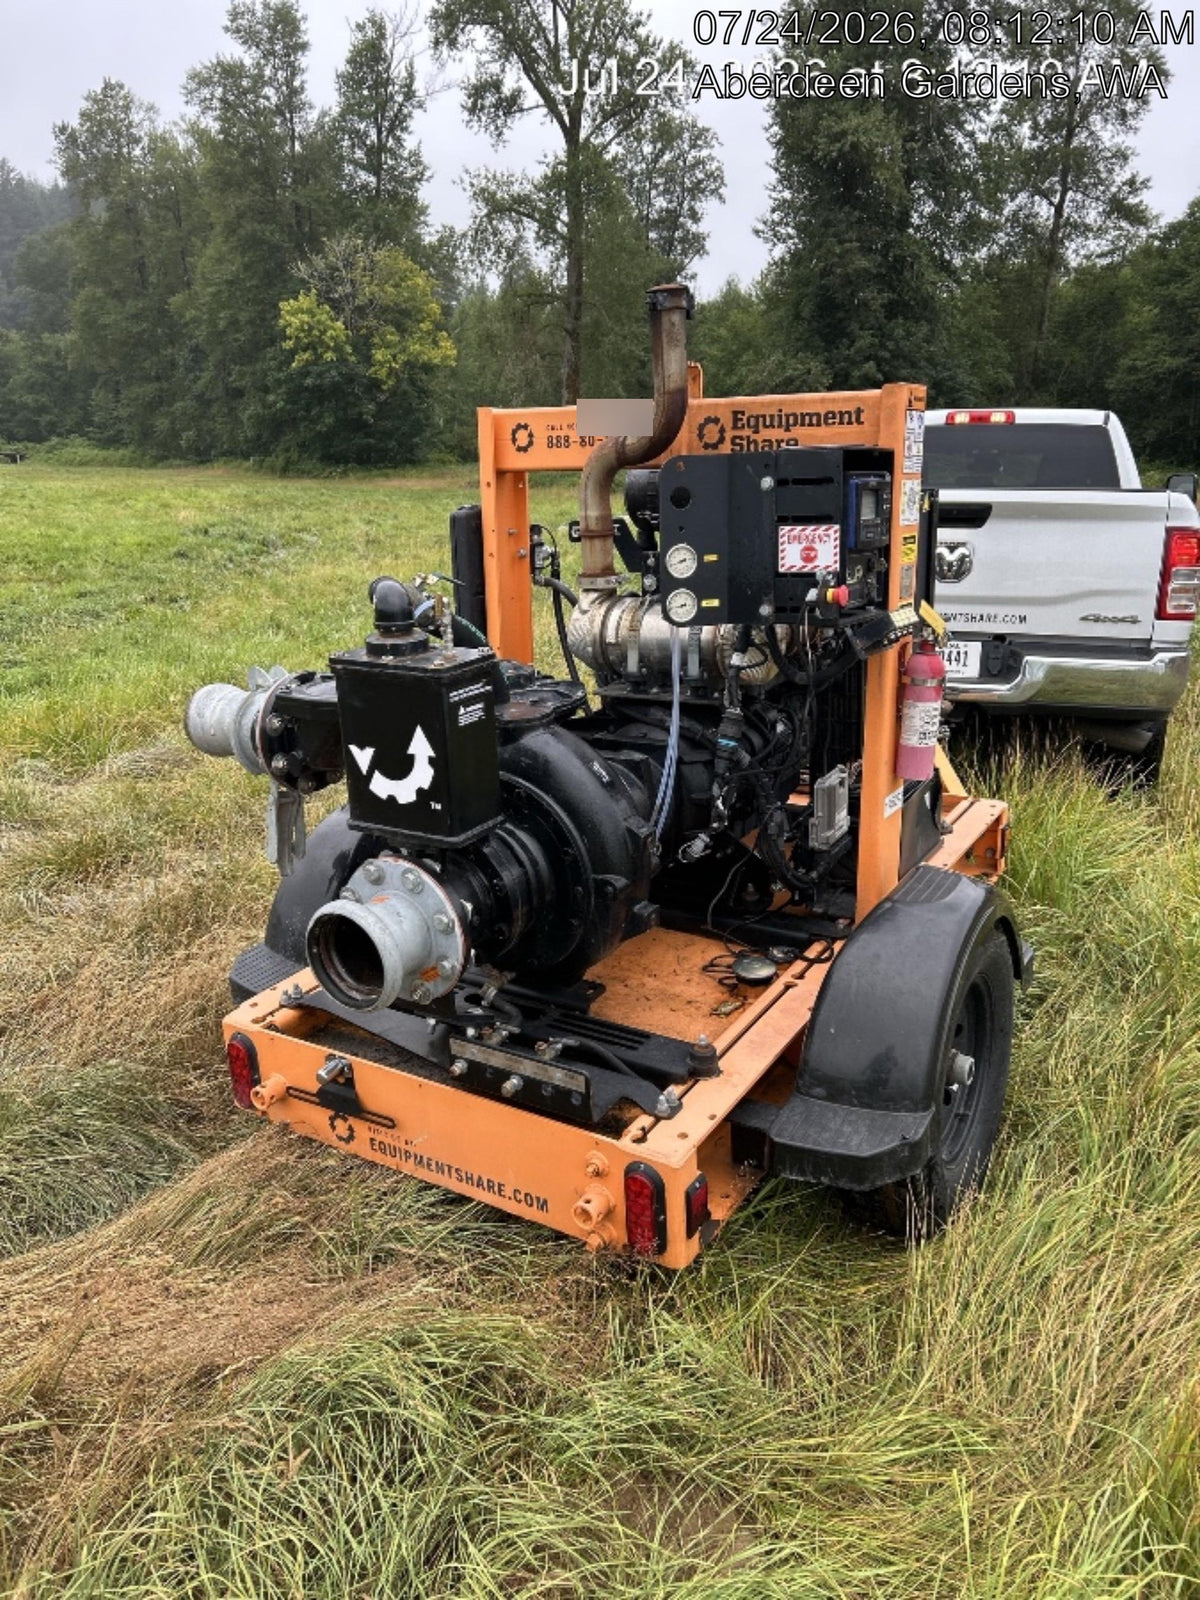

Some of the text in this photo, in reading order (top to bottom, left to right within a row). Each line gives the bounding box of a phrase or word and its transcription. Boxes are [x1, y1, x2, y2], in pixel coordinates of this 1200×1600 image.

[731, 406, 865, 434] Equipment
[730, 435, 800, 452] Share
[368, 1137, 550, 1214] EQUIPMENTSHARE.COM
